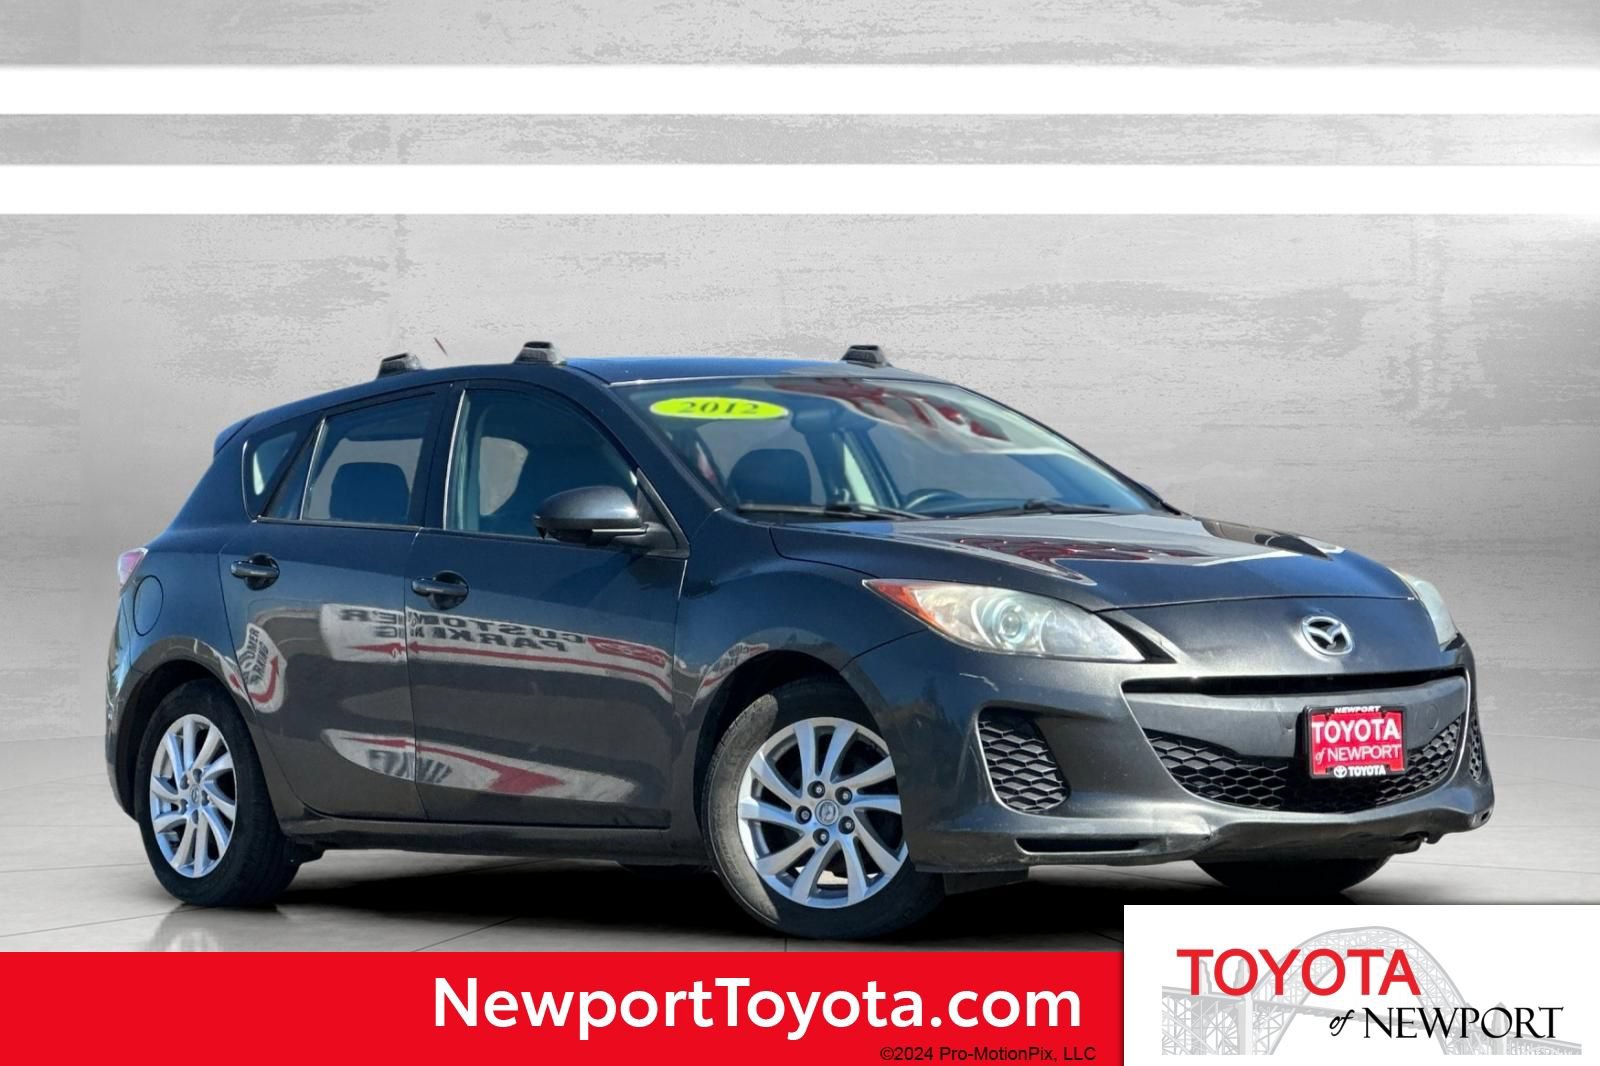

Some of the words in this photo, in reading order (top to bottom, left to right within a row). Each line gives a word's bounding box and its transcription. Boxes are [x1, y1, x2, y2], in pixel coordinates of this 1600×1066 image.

[676, 401, 760, 415] 2012
[1334, 705, 1381, 714] NEWPORT
[1311, 718, 1401, 744] TOYOTA
[1315, 747, 1327, 765] of
[1327, 744, 1402, 762] NEWPORT
[1348, 764, 1387, 777] TOYOTA
